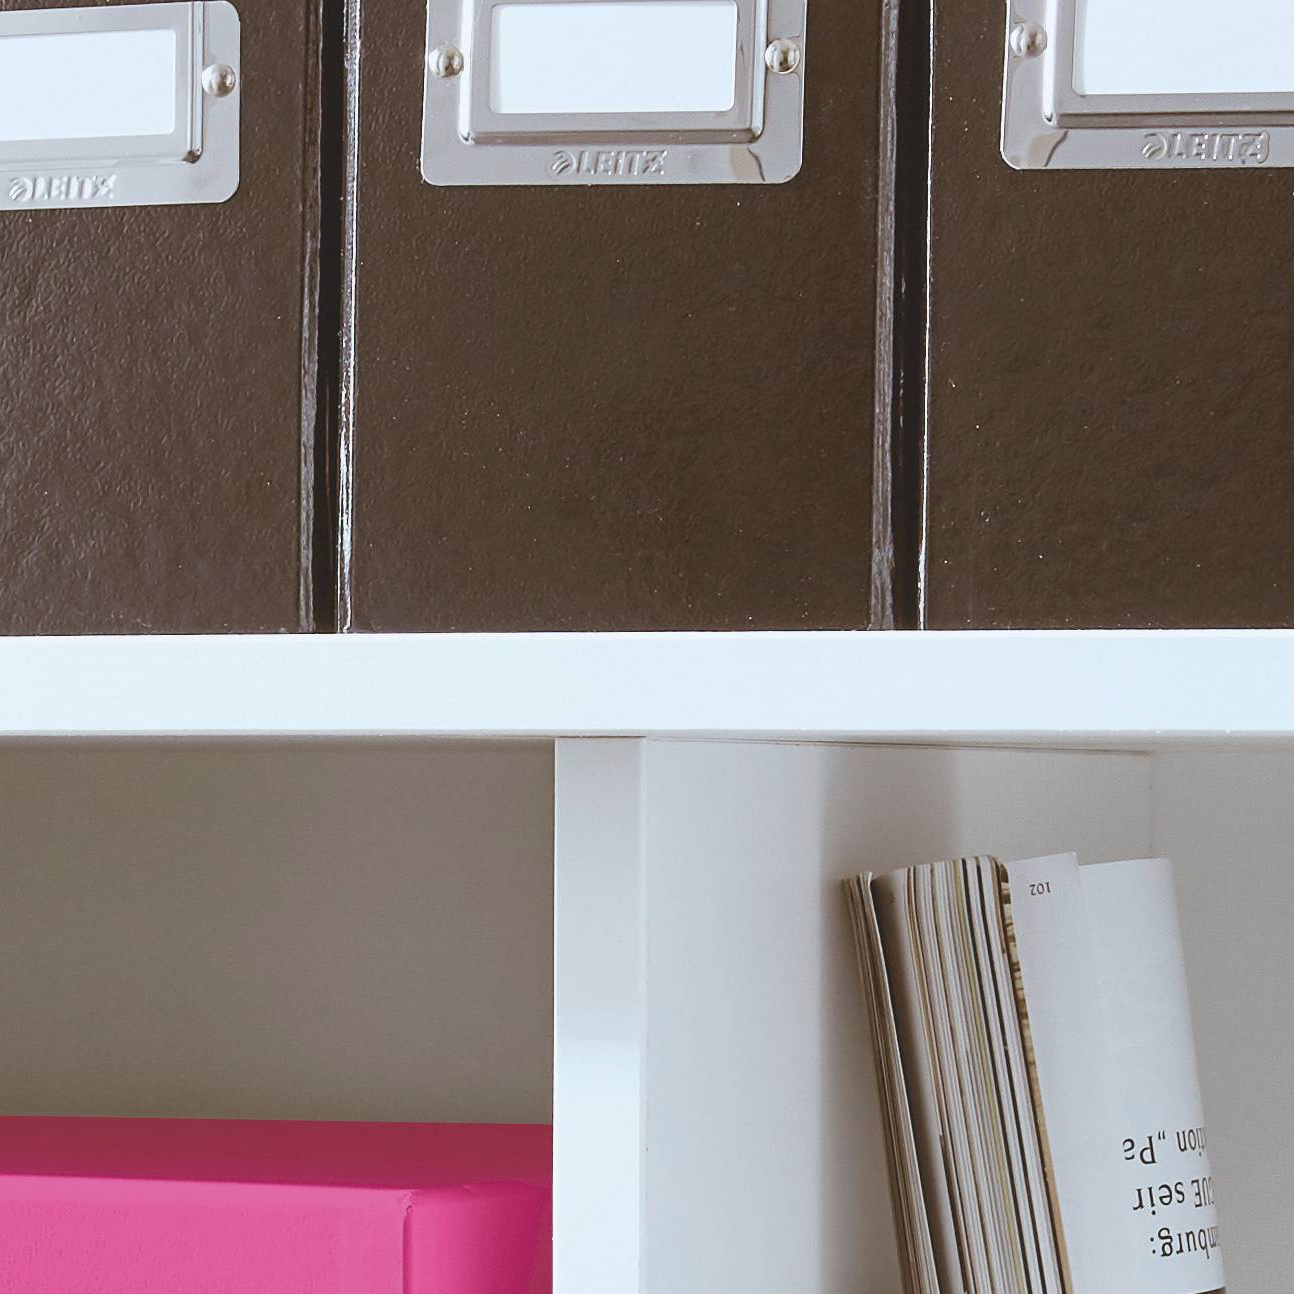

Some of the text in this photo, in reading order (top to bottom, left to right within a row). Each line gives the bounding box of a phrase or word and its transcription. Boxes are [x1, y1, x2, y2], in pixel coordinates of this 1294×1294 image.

[1169, 131, 1266, 161] LEITZ
[577, 149, 668, 177] LEITZ
[32, 173, 117, 201] LEITZ
[1028, 881, 1052, 897] 102
